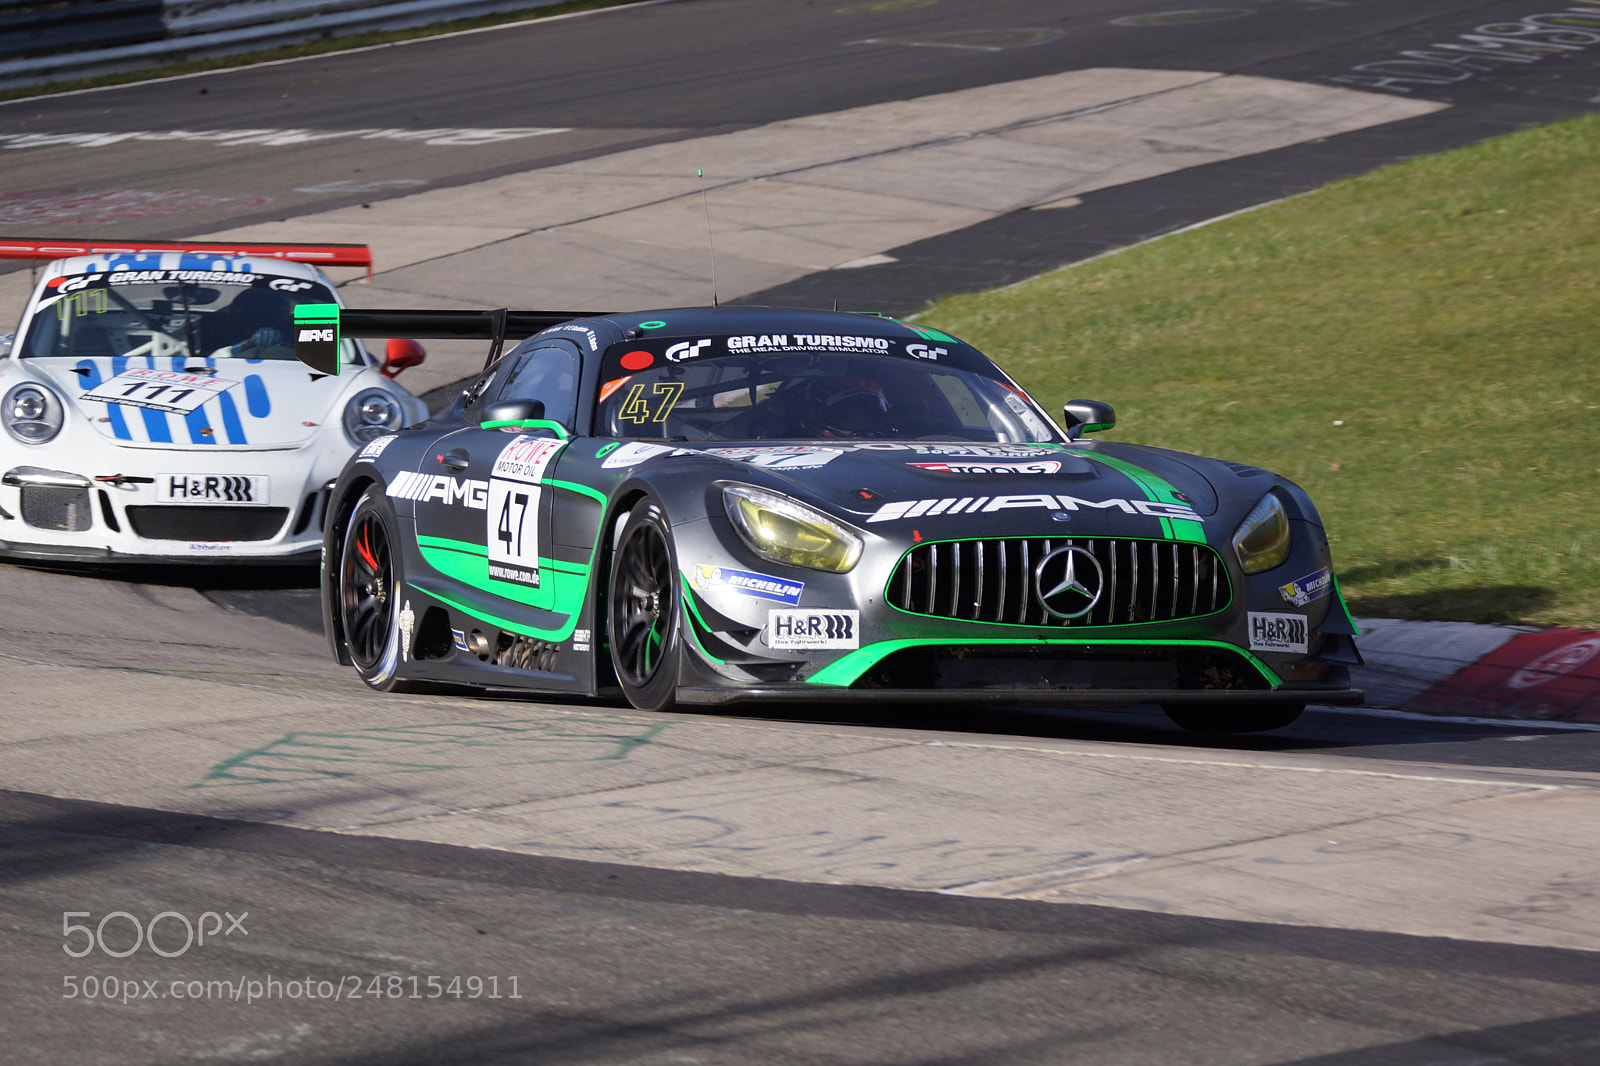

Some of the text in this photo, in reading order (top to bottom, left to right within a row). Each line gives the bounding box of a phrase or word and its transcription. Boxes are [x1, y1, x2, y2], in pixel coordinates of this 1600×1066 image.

[108, 271, 256, 283] GRAN TURISMO
[51, 288, 108, 321] 111
[309, 329, 334, 342] AMG
[727, 334, 889, 350] GRAN TURISMO
[829, 346, 889, 355] SIMULATOR
[132, 370, 225, 386] ROWE
[121, 381, 196, 404] 111
[618, 382, 685, 424] 47
[502, 439, 557, 465] ROWE
[496, 461, 536, 477] MOTOR OIL
[170, 475, 221, 499] H&R
[423, 474, 489, 510] AMG
[981, 494, 1205, 523] AMG
[498, 490, 530, 557] 47
[488, 565, 540, 586] www.rowe.com.de
[728, 575, 801, 597] MICHELIN
[775, 614, 823, 637] H&R
[1252, 616, 1287, 640] H&R
